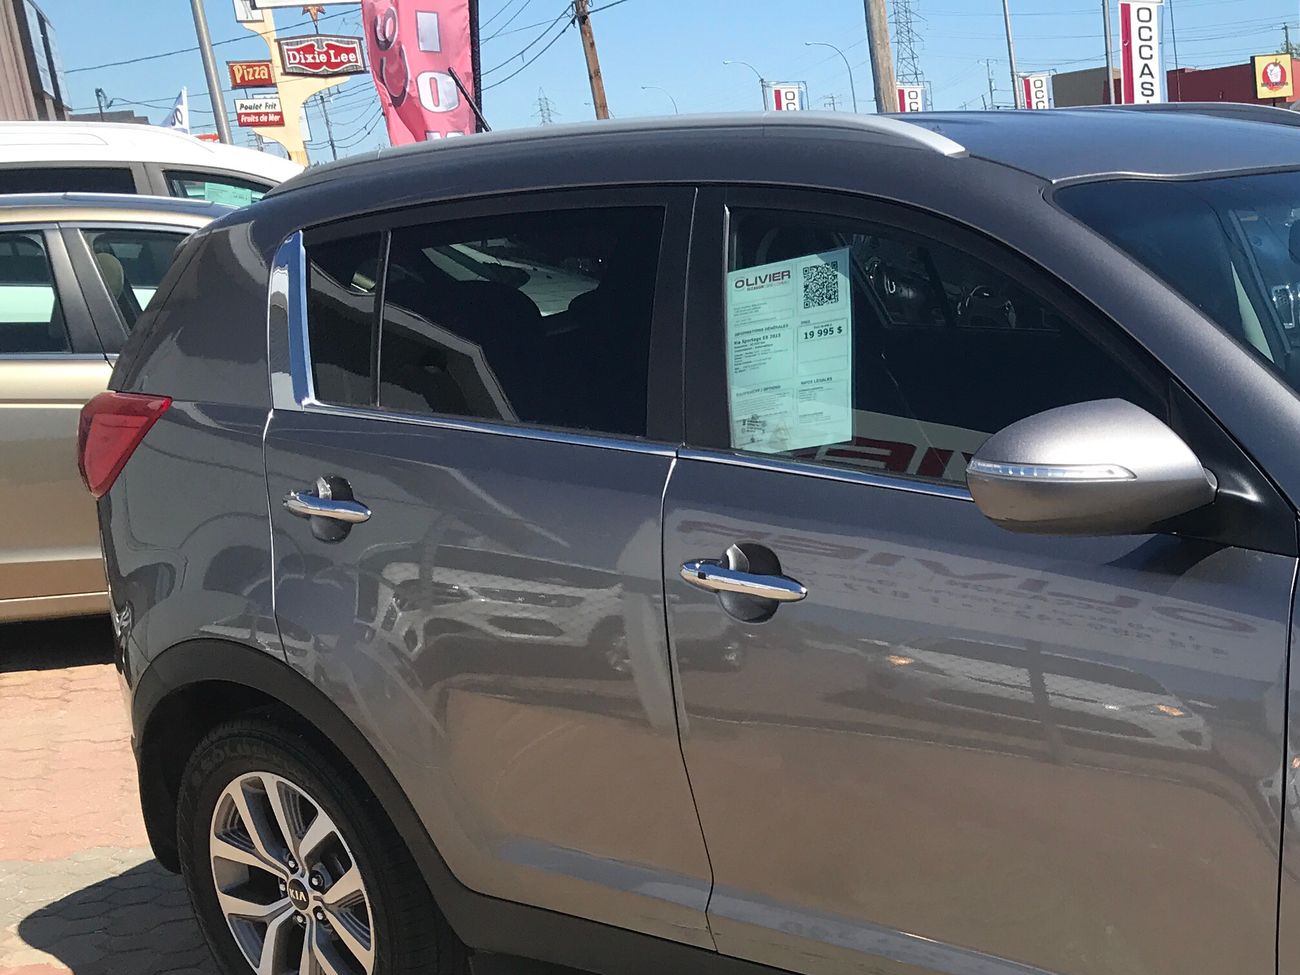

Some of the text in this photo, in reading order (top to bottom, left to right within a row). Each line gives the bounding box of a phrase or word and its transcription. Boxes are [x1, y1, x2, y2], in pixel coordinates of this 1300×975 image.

[288, 50, 356, 64] Dixie Lee
[1137, 7, 1155, 103] OCCAS
[233, 64, 269, 83] Pizza
[264, 102, 277, 110] Frit
[241, 113, 281, 123] Fruits de Mer
[735, 270, 791, 289] OLIVIER
[804, 330, 815, 340] 19
[818, 327, 834, 337] 995
[837, 325, 843, 334] $
[289, 889, 307, 902] KIA
